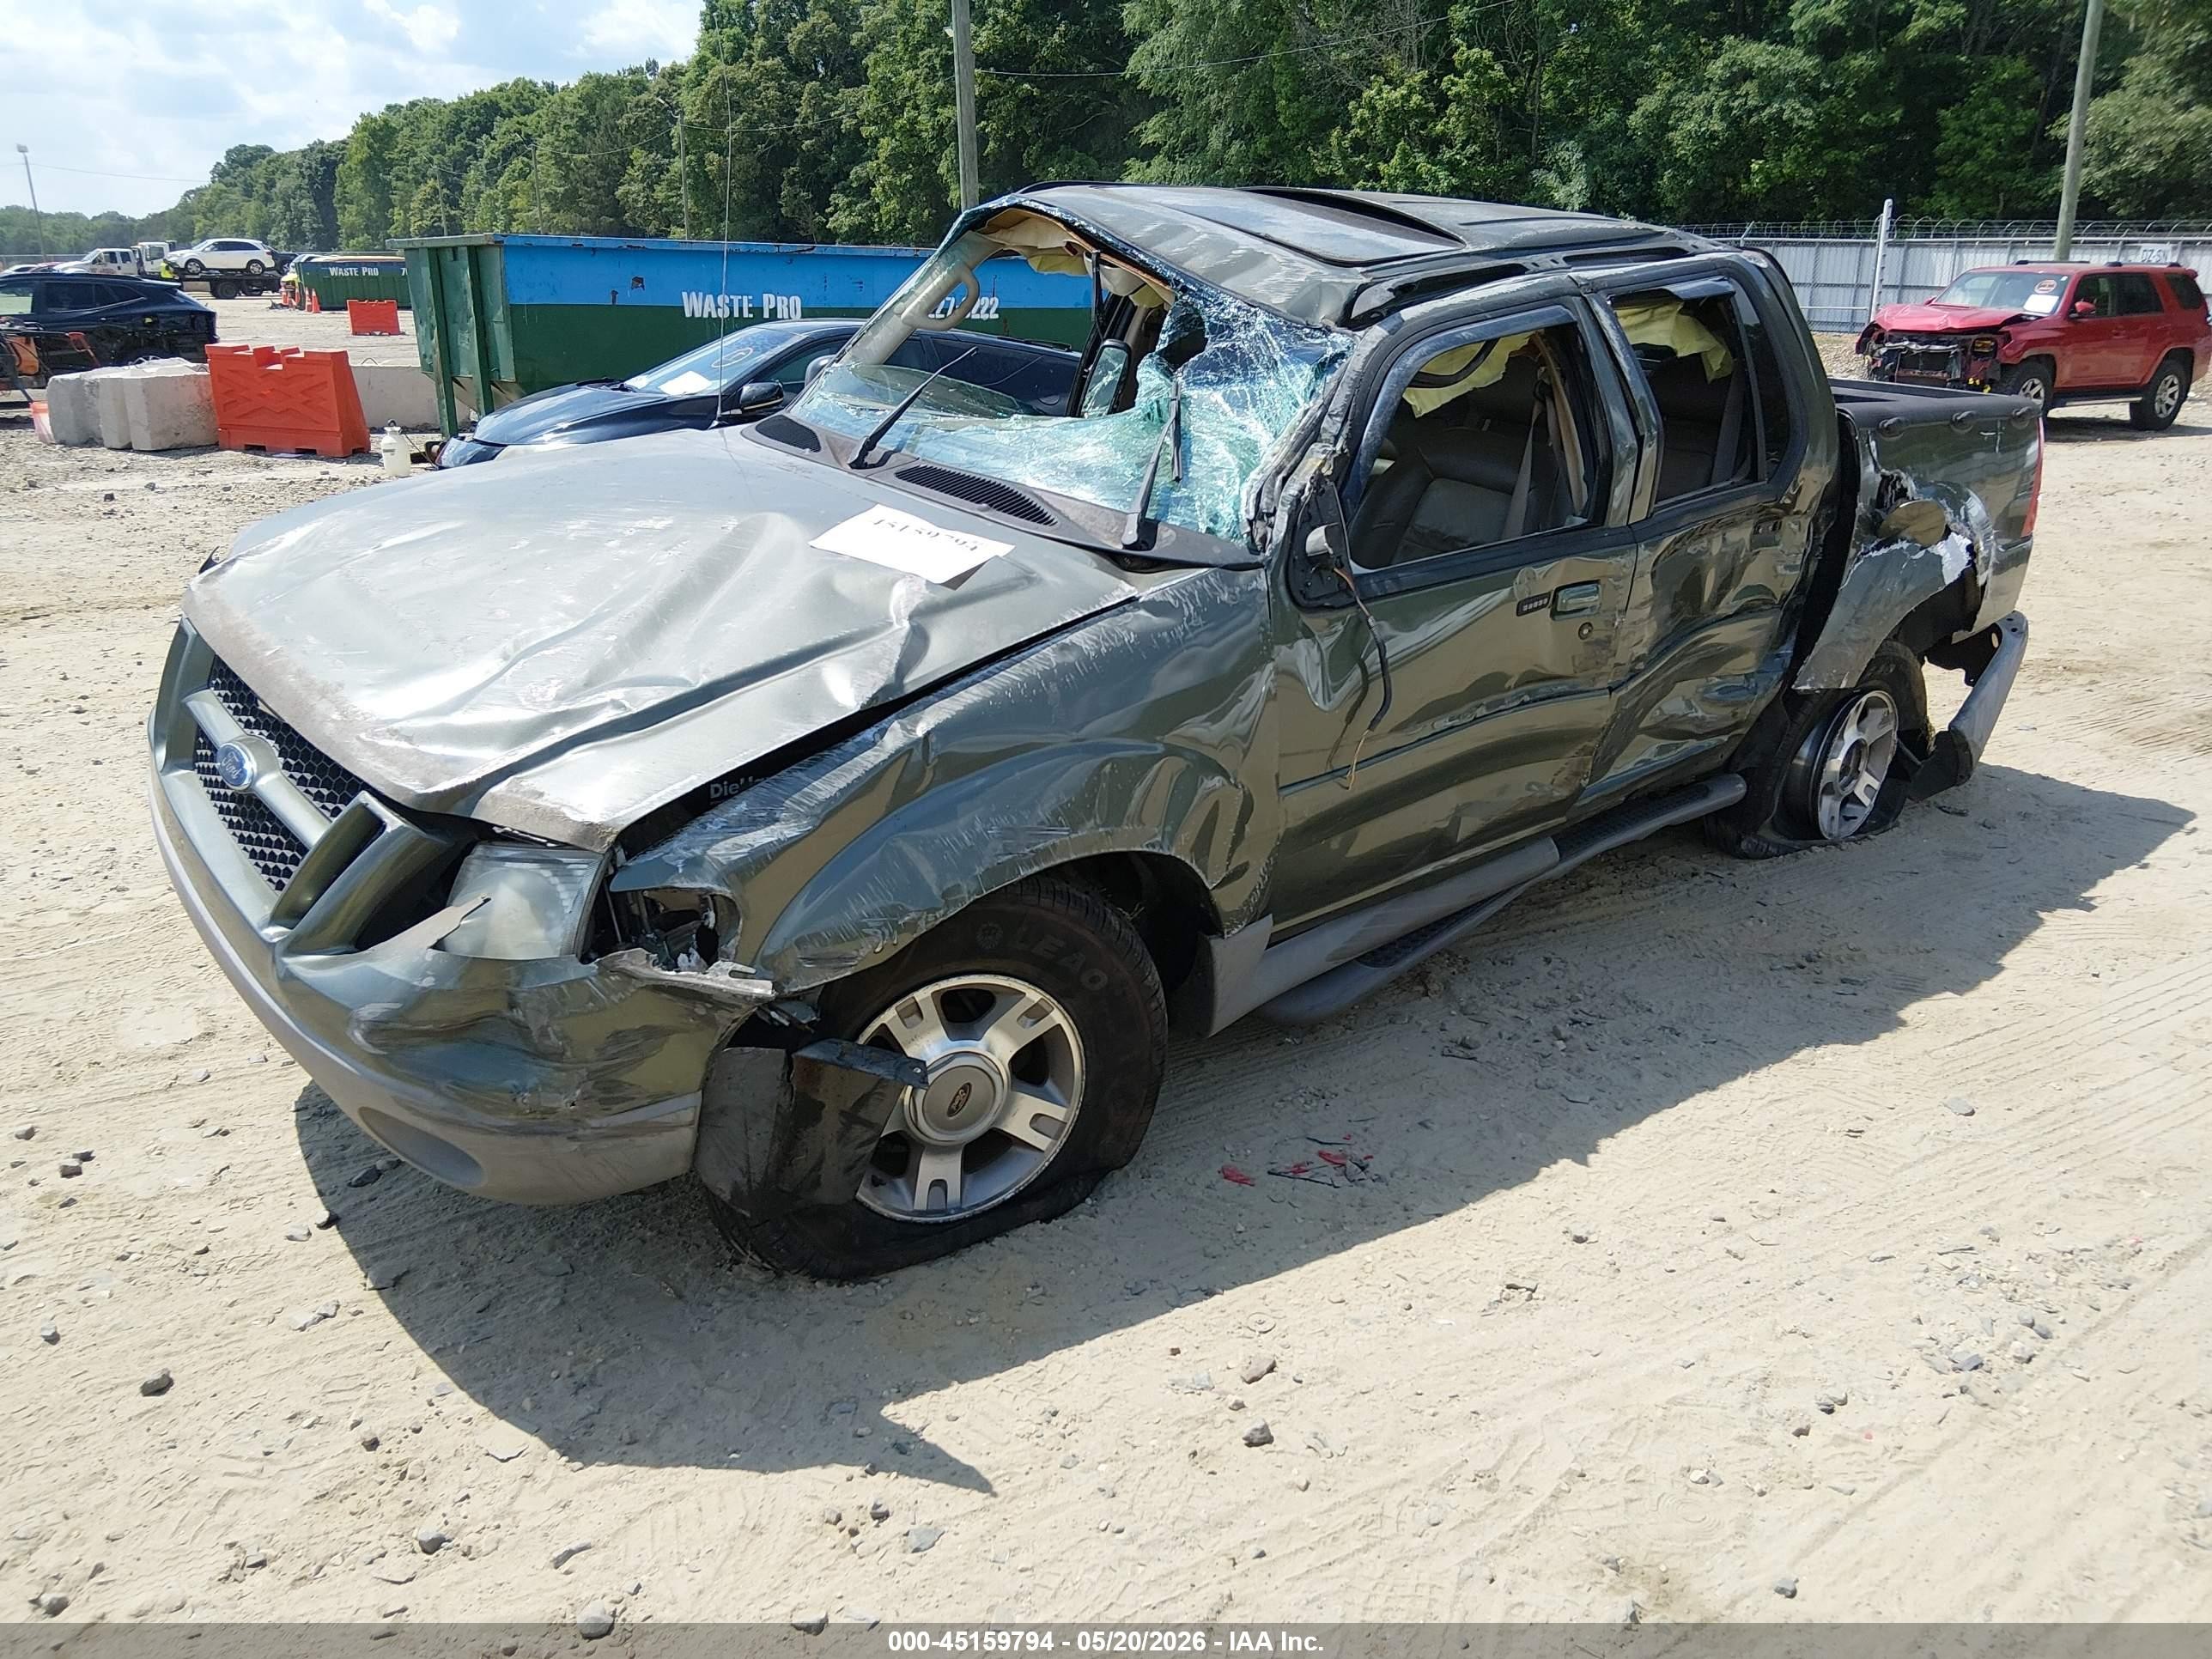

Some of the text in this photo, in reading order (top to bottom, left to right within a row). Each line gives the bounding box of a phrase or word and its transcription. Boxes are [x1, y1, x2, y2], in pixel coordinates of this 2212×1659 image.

[329, 266, 359, 276] WASTE
[362, 266, 380, 276] PRO
[681, 290, 755, 319] WASTE
[762, 293, 803, 319] PRO
